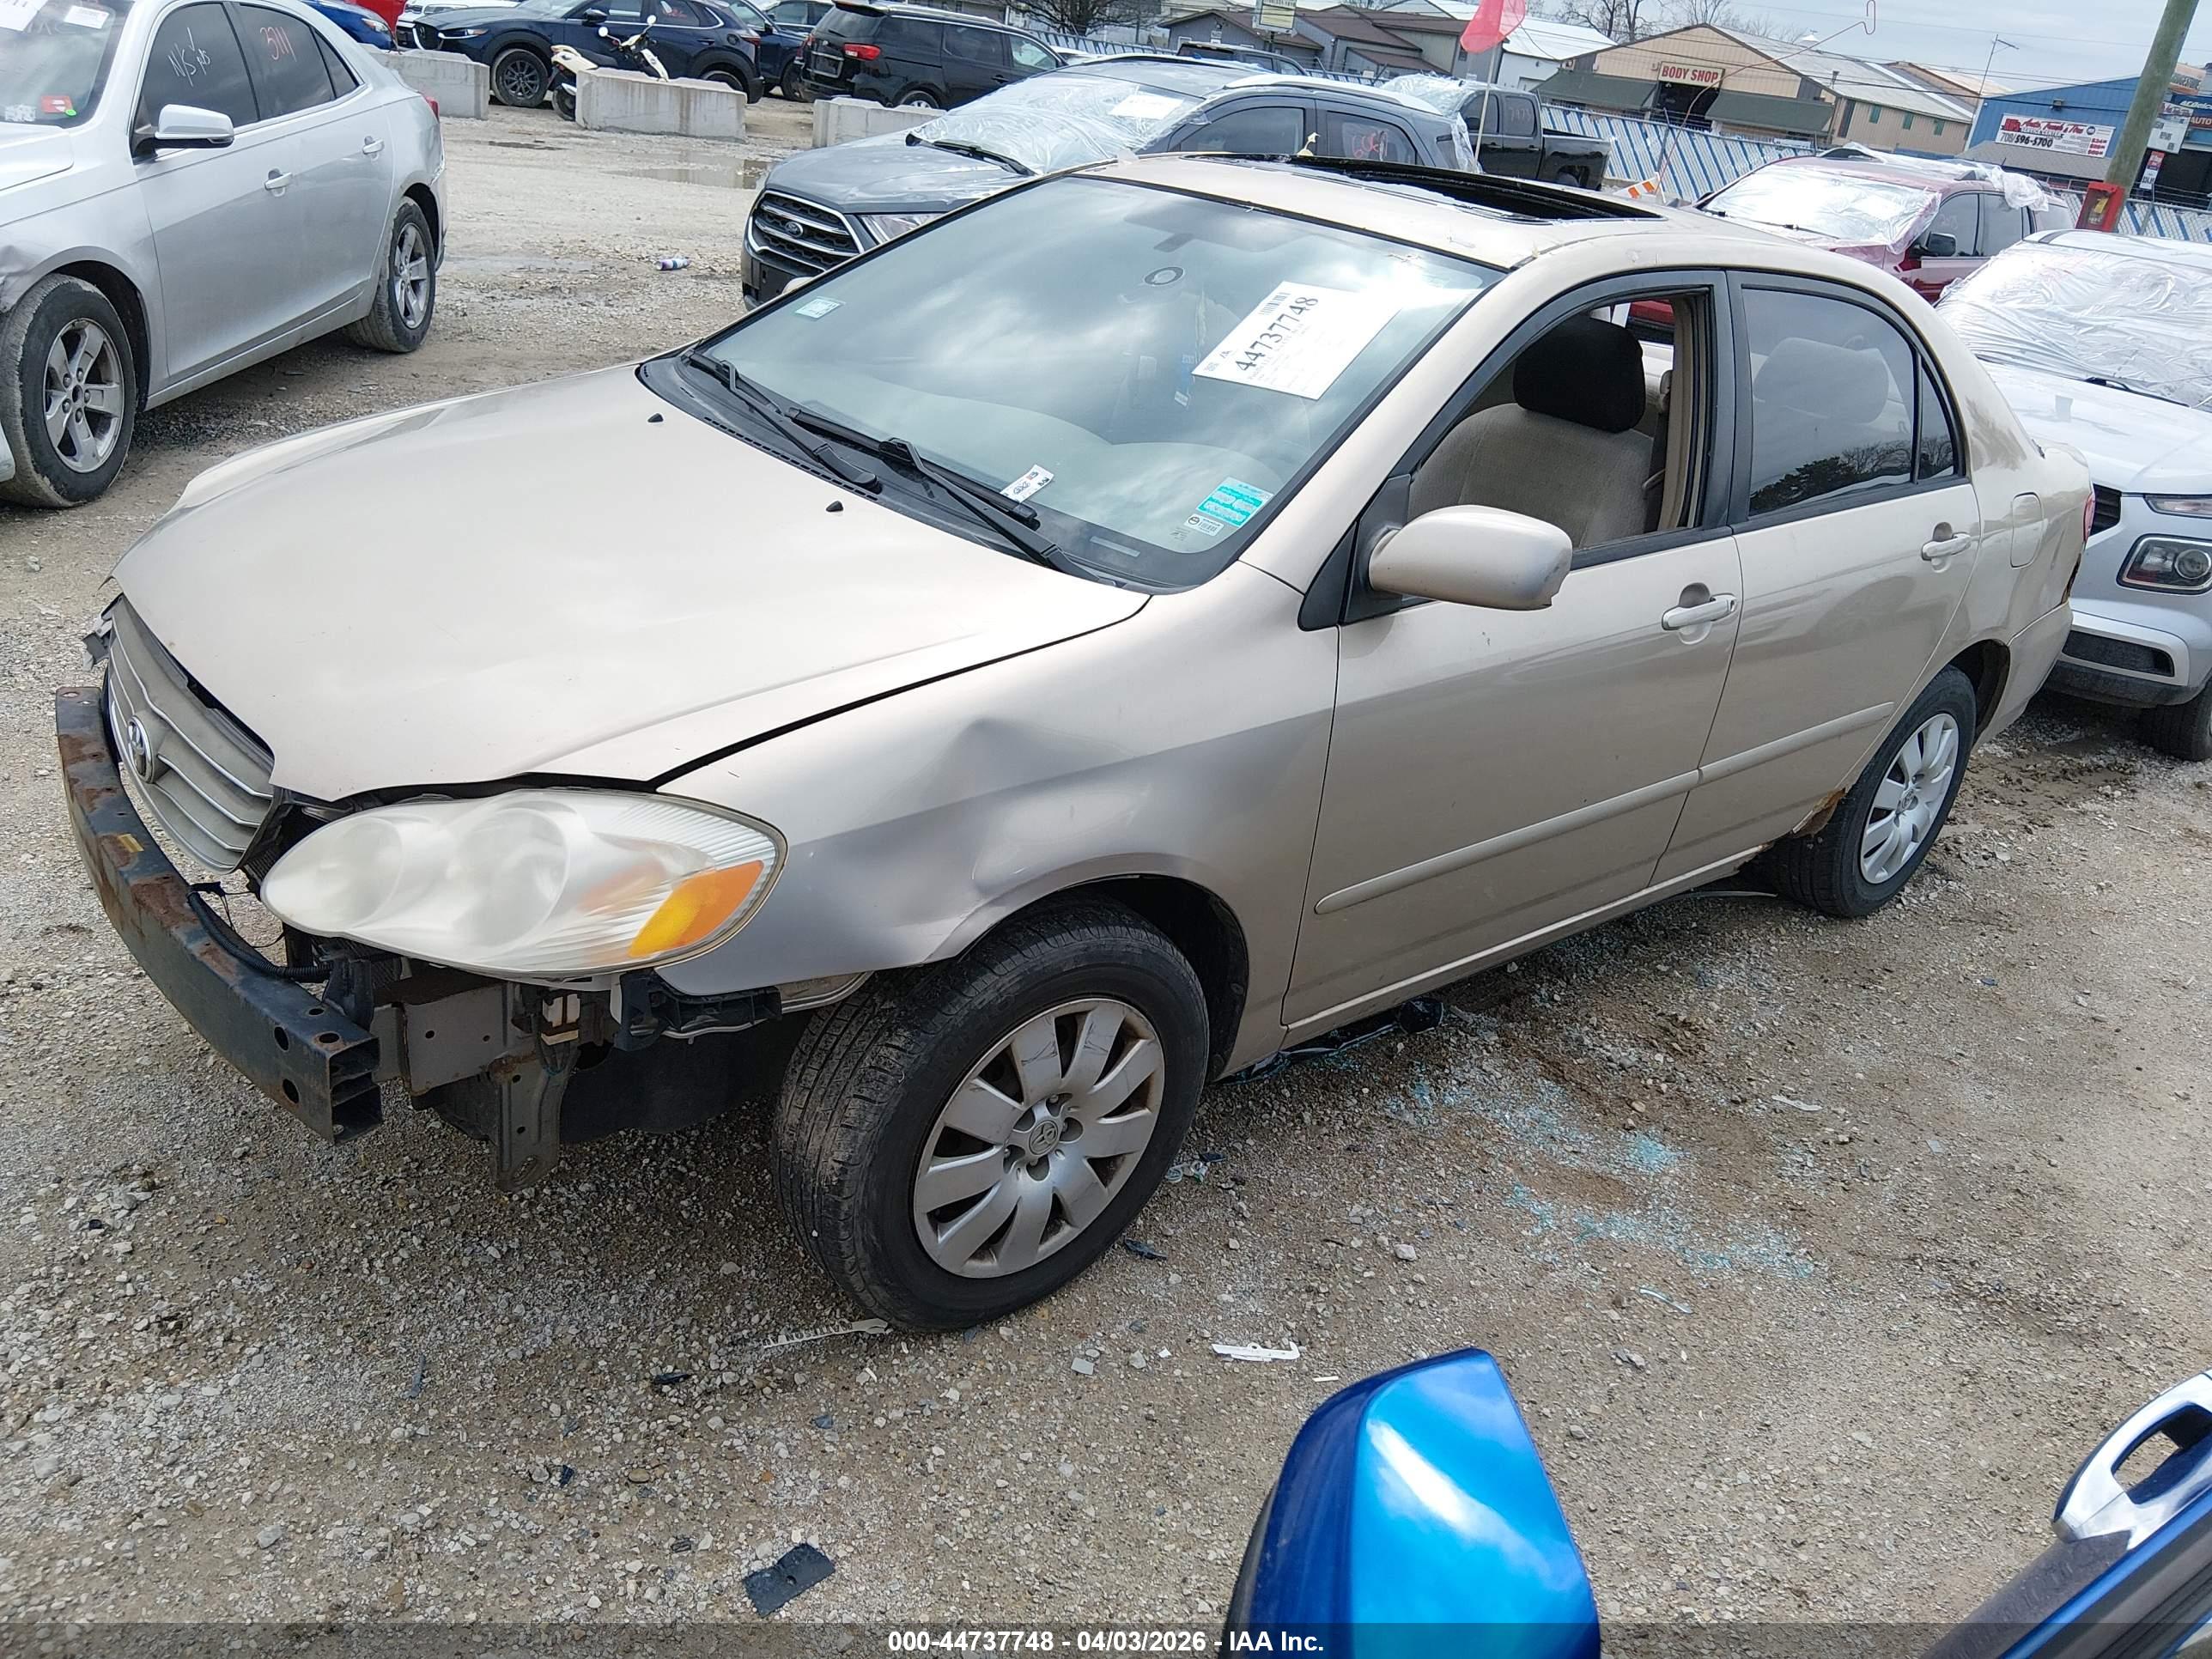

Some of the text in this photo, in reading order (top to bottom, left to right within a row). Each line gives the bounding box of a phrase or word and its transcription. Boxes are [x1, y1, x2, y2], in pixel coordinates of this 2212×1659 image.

[1661, 65, 1719, 83] BODY SHOP
[1235, 296, 1319, 372] 44737748
